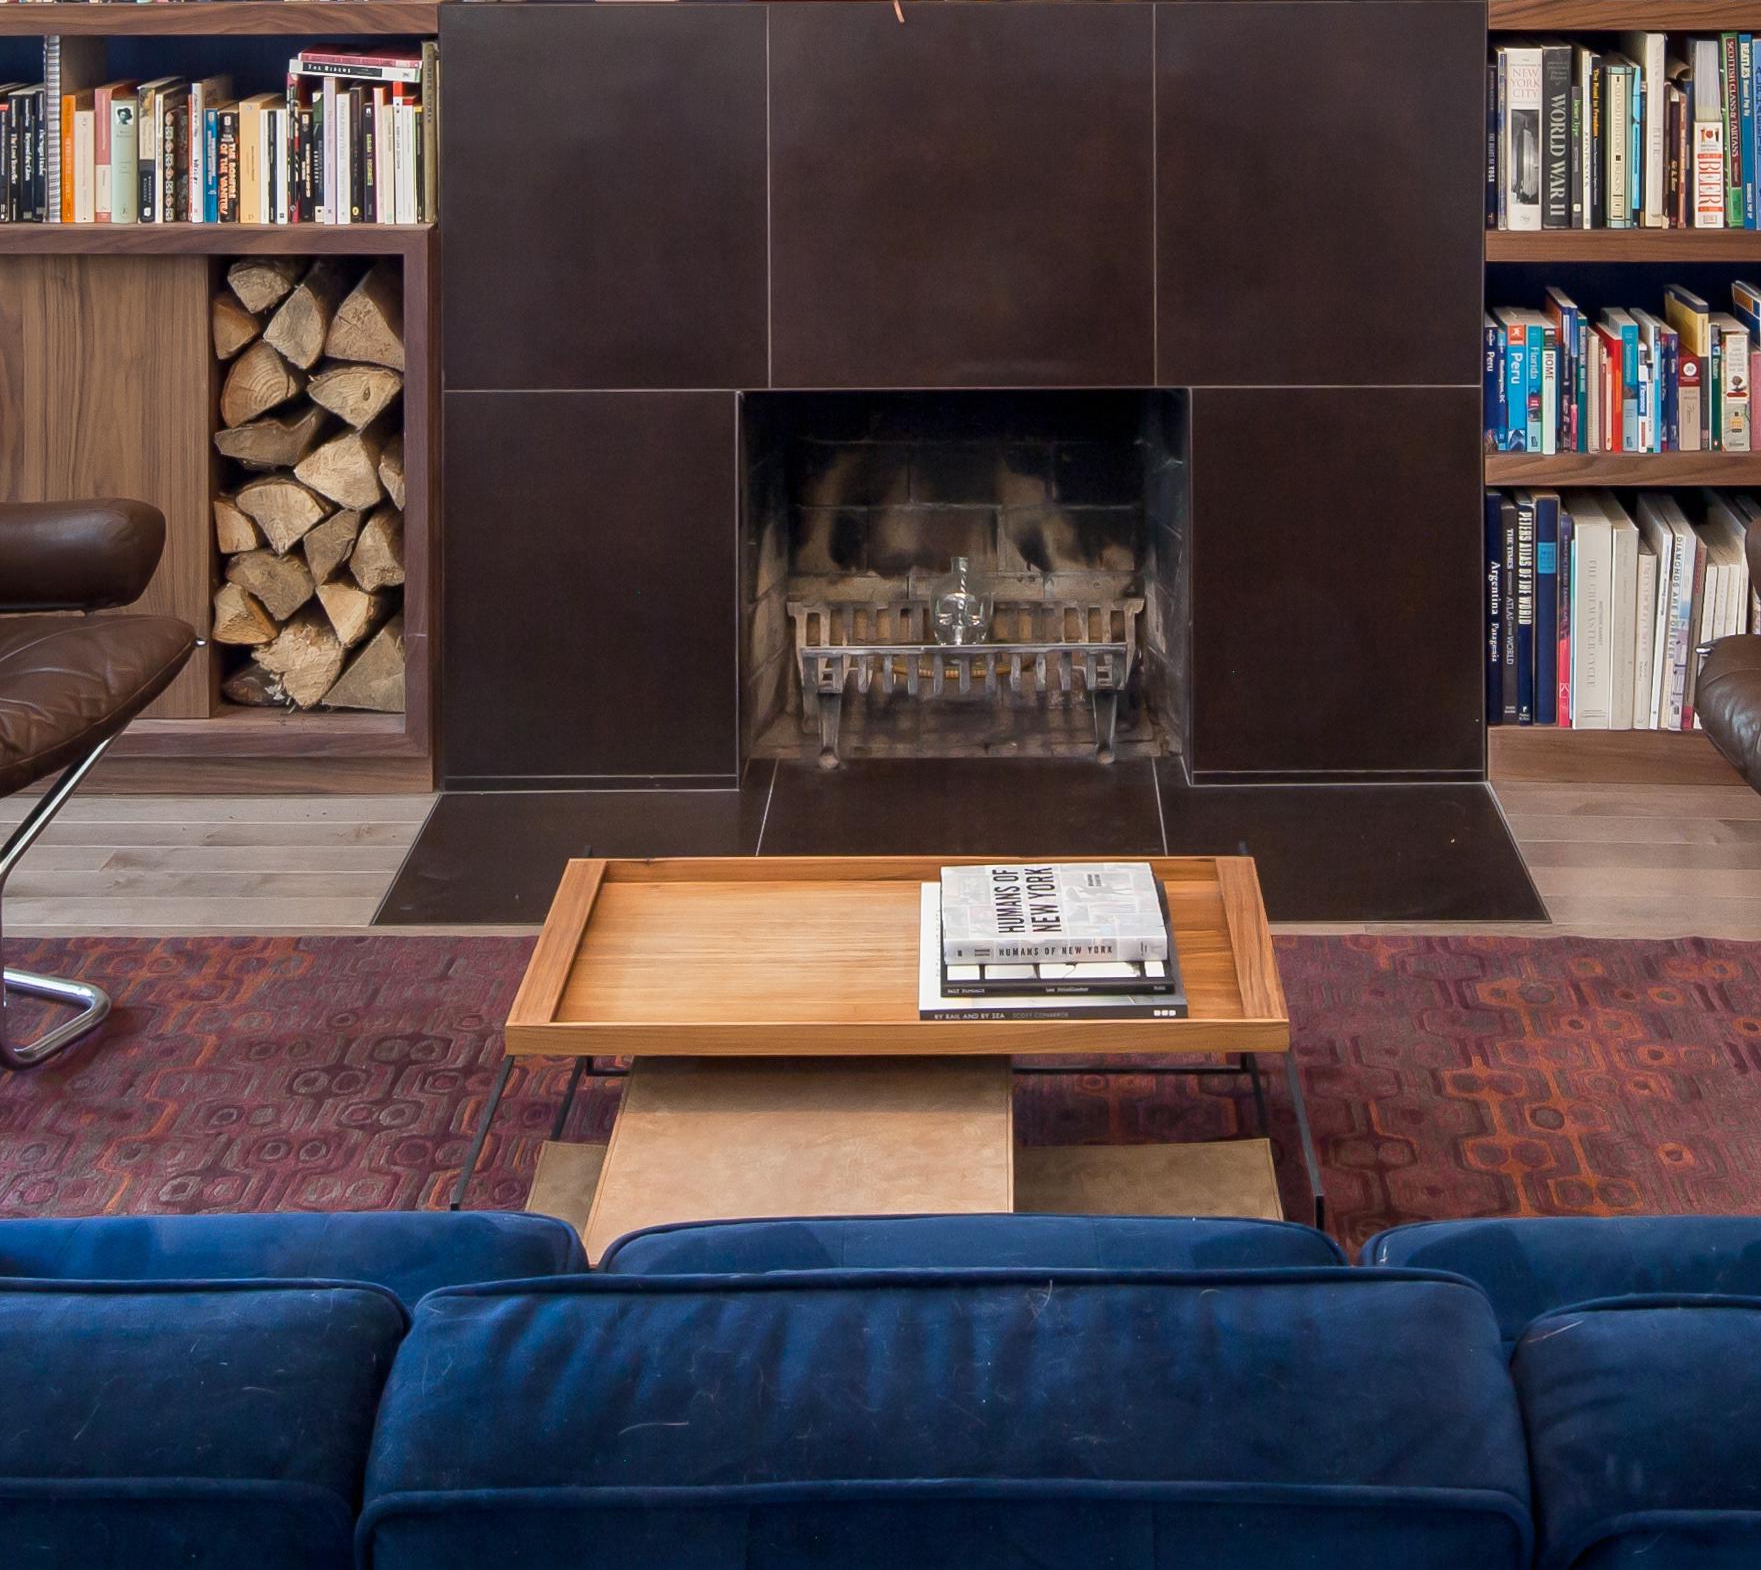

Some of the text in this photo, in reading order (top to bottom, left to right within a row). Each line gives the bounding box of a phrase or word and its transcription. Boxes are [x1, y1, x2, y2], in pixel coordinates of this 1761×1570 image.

[1509, 79, 1539, 87] YORK
[1513, 68, 1533, 77] NEW
[1513, 90, 1540, 98] CITY
[1549, 95, 1566, 215] WORLD WAR II
[1698, 160, 1720, 205] BEER
[1486, 352, 1495, 371] Peru
[1510, 353, 1522, 384] Peru
[1530, 347, 1539, 379] Florida
[1545, 354, 1554, 380] ROME
[1490, 562, 1500, 662] Argentina Patagonia
[992, 869, 1025, 934] HUMANS OF
[1024, 867, 1062, 933] NEW YORK
[999, 945, 1112, 956] HUMANS OF NEW YORK
